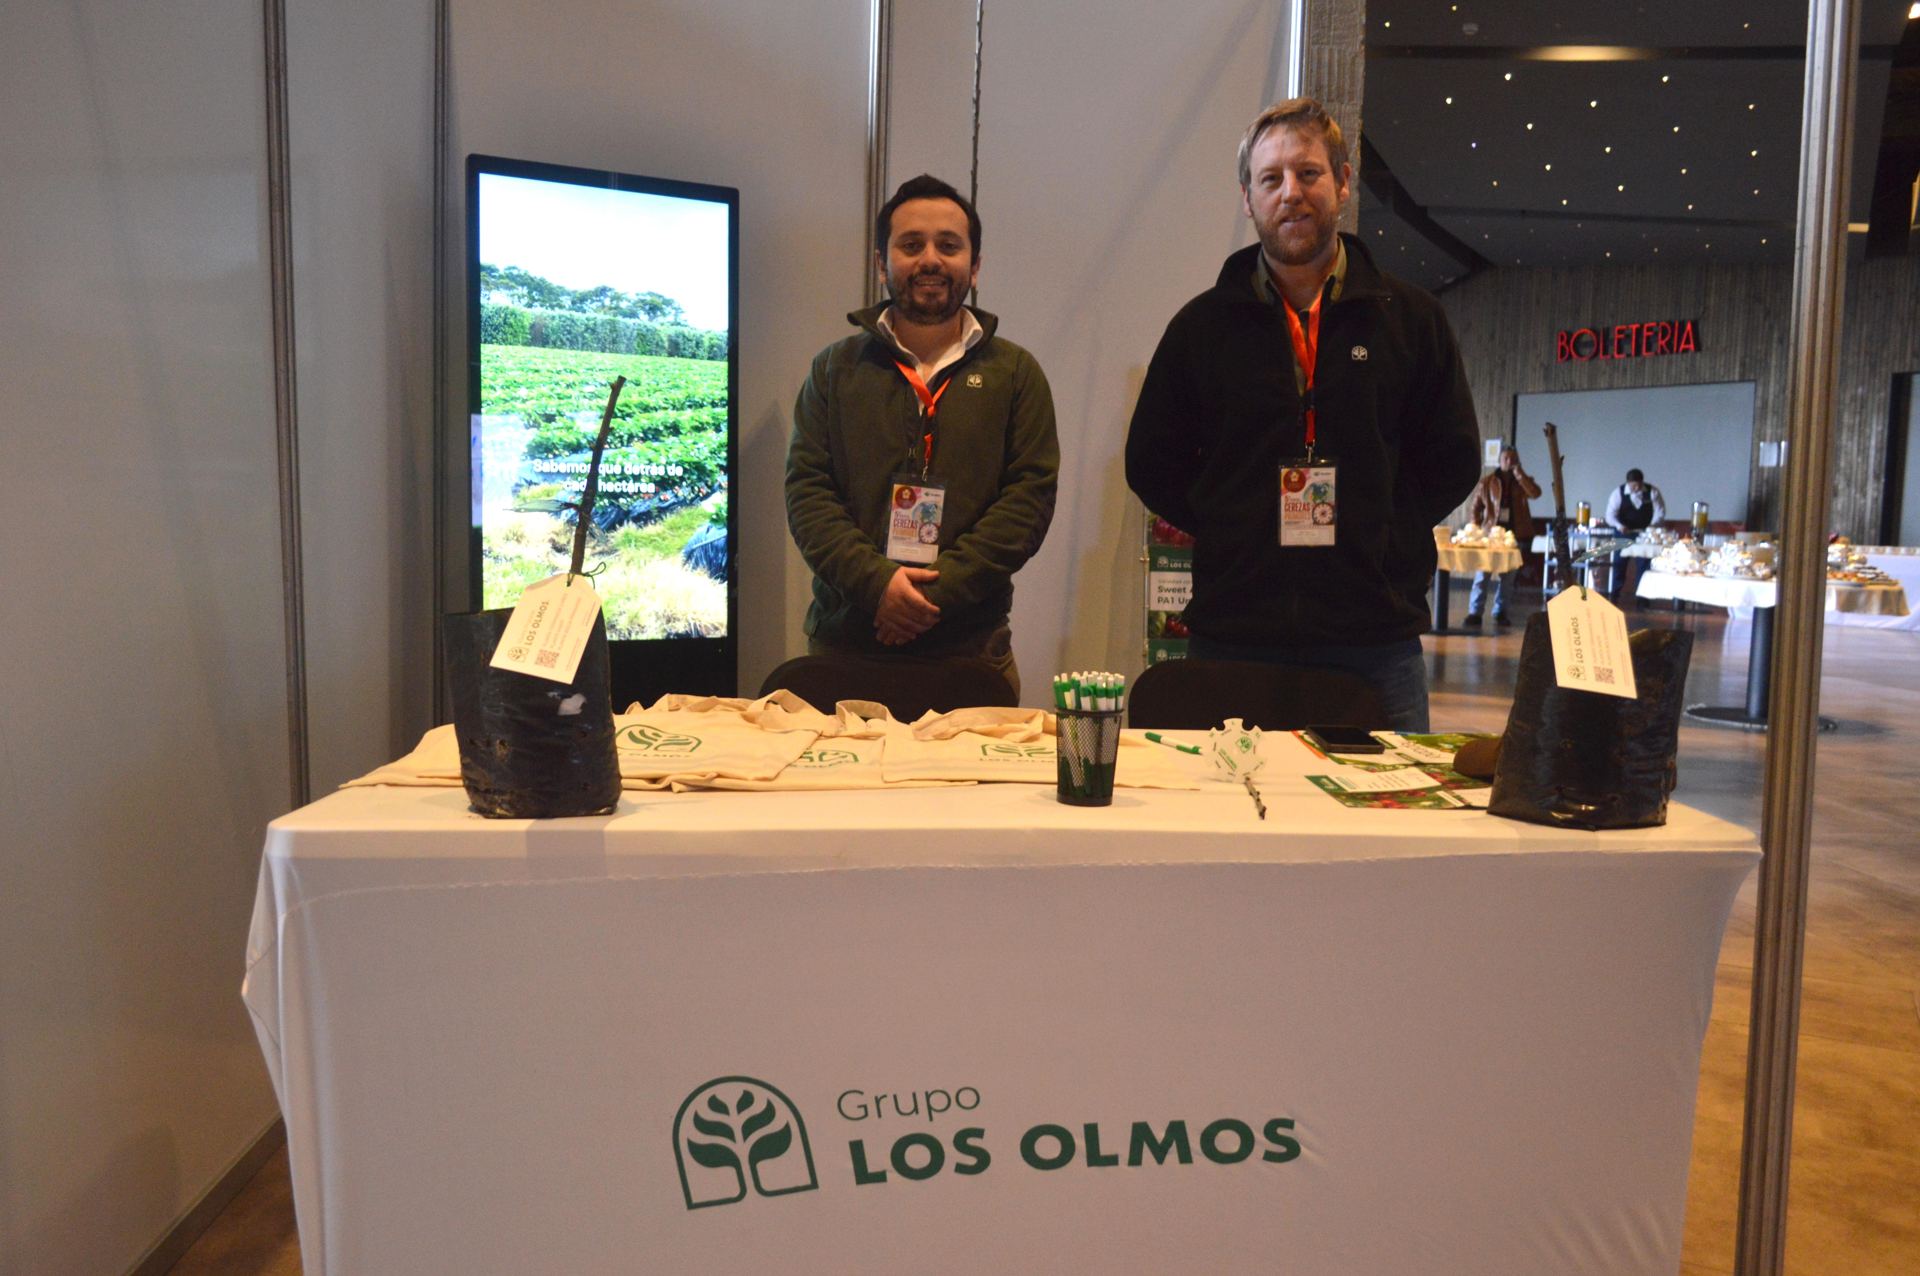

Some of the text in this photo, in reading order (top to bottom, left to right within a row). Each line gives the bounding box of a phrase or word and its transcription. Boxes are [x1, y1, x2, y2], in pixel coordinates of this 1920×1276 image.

[1556, 320, 1696, 363] BOLETERIA
[564, 478, 587, 492] cad
[598, 463, 622, 476] que
[667, 464, 683, 476] de
[1157, 585, 1186, 593] Sweet
[525, 630, 537, 646] LOS
[532, 600, 549, 629] OLMOS
[1571, 617, 1584, 664] LOS OLMOS
[837, 1086, 981, 1122] Grupo
[848, 1118, 1302, 1186] LOS OLMOS
